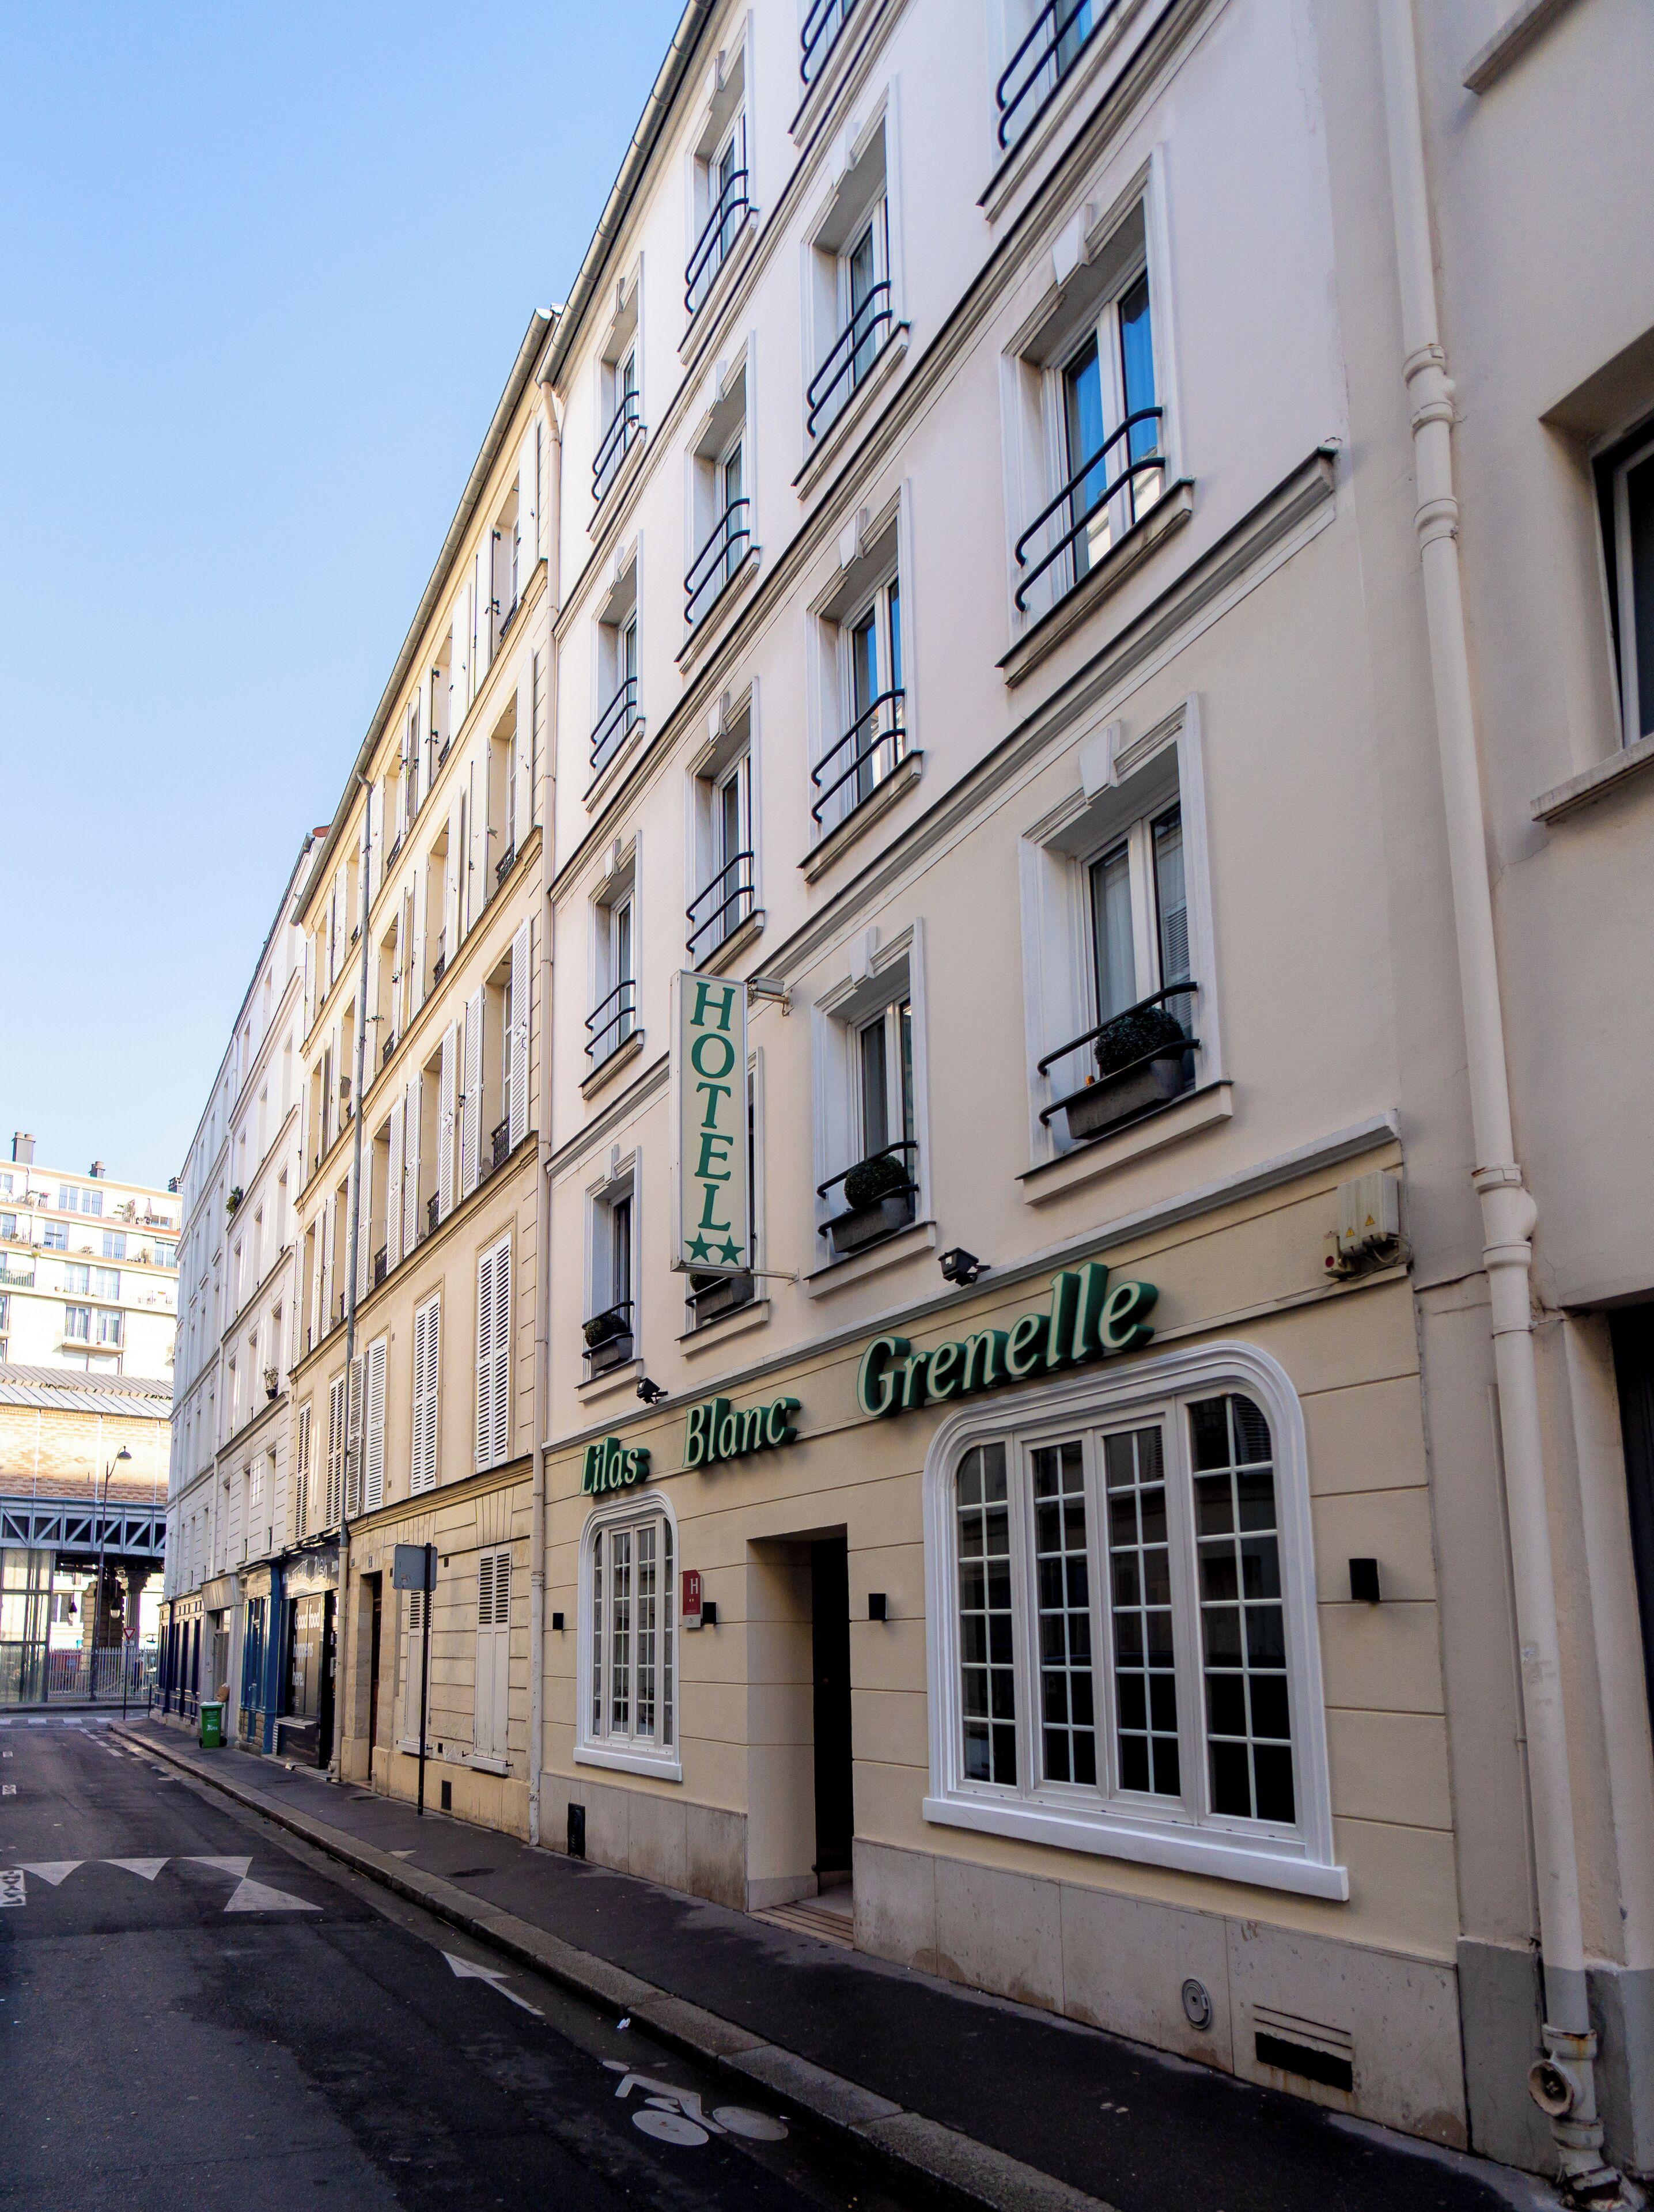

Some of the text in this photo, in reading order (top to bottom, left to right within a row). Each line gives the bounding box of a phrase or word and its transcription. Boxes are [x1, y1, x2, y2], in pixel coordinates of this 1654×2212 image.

[690, 982, 735, 1231] HOTEL
[580, 1262, 1159, 1497] Lilas Blanc Grenelle
[690, 1578, 698, 1594] H
[295, 1603, 320, 1630] Good food
[293, 1635, 313, 1664] happens
